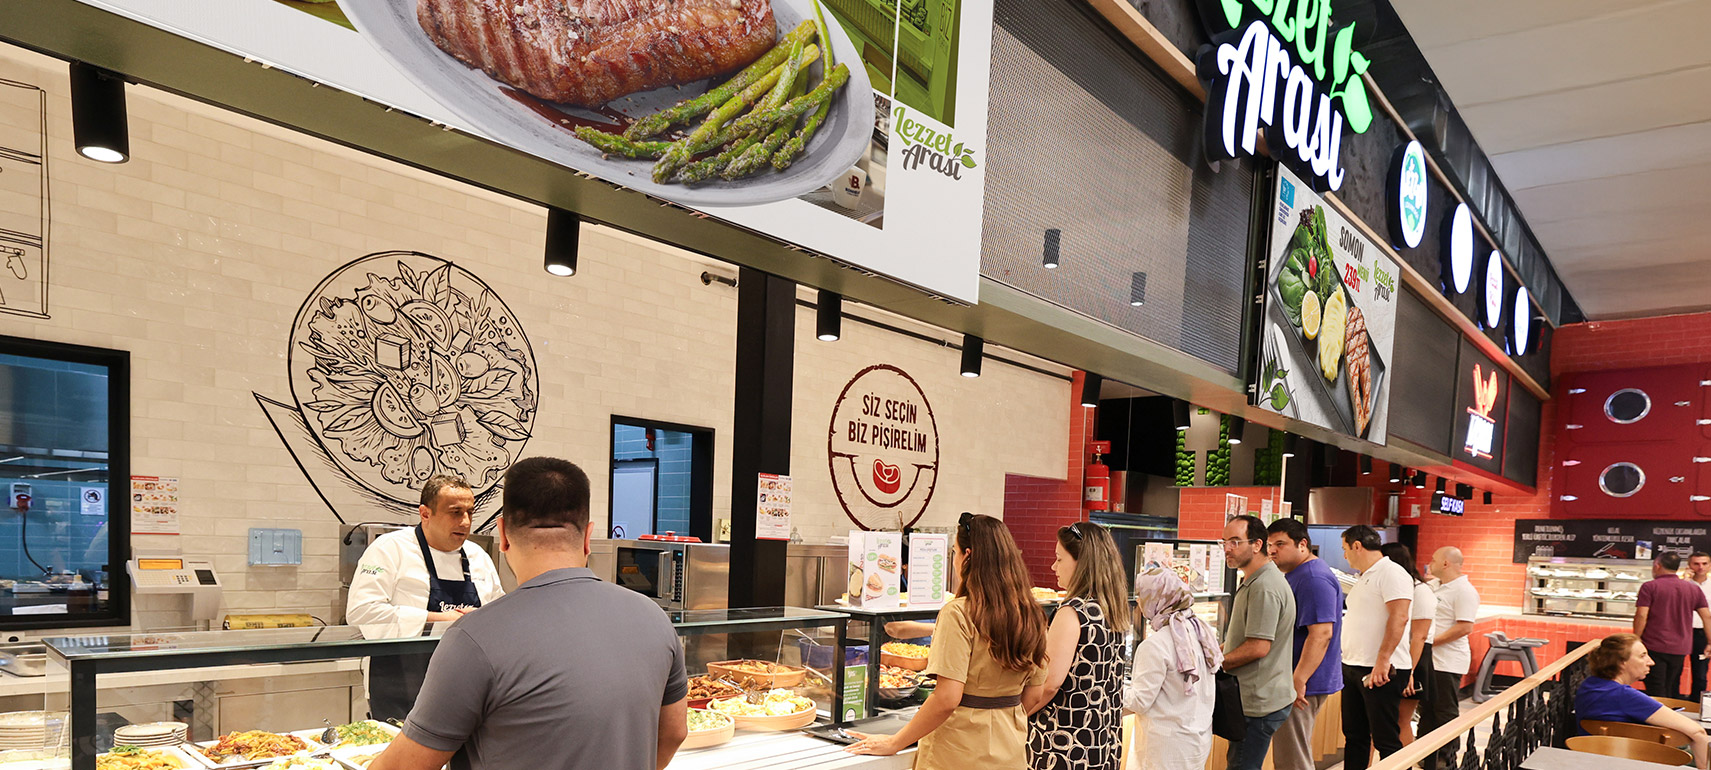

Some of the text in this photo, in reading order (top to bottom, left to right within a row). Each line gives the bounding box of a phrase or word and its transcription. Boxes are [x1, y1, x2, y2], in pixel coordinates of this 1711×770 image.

[1216, 20, 1345, 192] Arası
[893, 106, 953, 156] Lezzet
[901, 144, 962, 181] Arası
[1339, 226, 1365, 263] SOMON
[862, 392, 917, 424] SİZ SEÇİN
[847, 418, 927, 454] BİZ PİŞİRELİM
